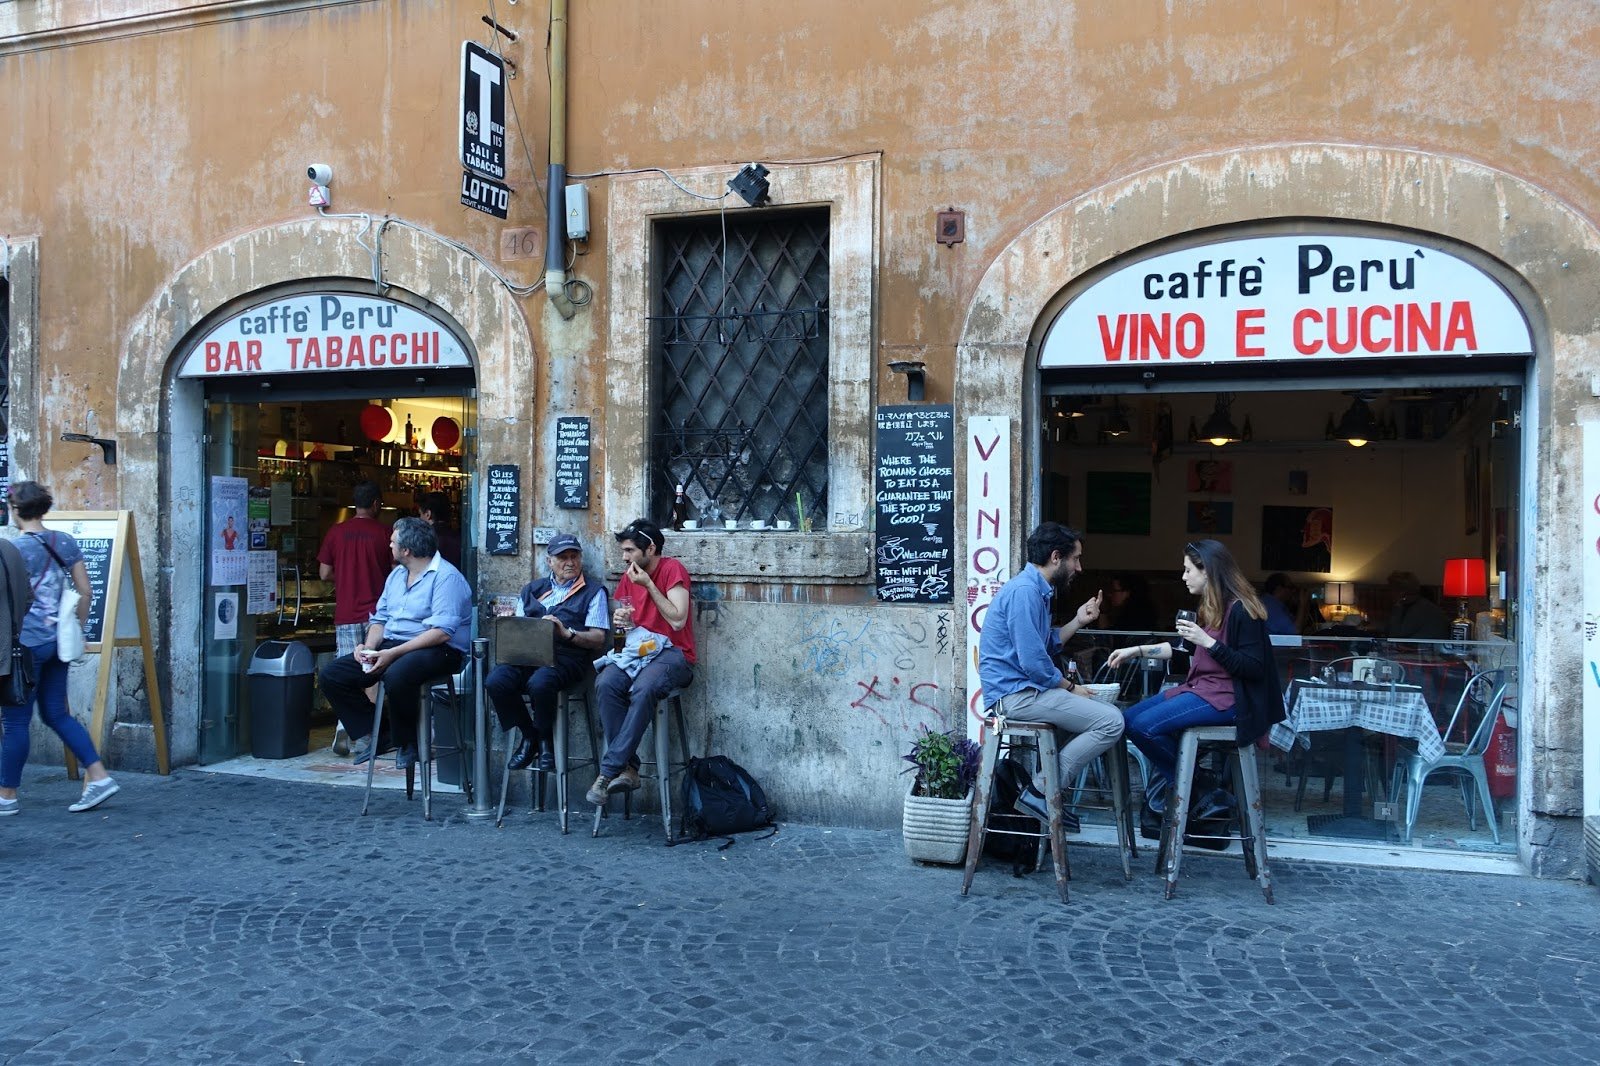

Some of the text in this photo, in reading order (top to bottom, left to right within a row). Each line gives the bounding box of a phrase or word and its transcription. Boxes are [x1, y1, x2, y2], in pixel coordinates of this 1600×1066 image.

[469, 51, 501, 147] T
[470, 142, 499, 163] SALI E
[465, 152, 503, 178] TABACCHI
[462, 174, 509, 211] LOTTO
[504, 231, 538, 255] 46
[1143, 257, 1266, 300] caffè
[239, 305, 311, 335] caffè
[1097, 301, 1479, 362] VINO E CUCINA
[205, 331, 440, 373] BAR TABACCHI
[904, 431, 925, 441] カフェ
[880, 454, 937, 466] WHERE THE
[878, 466, 952, 477] ROMANS CHOOSE
[898, 478, 917, 488] EAT
[919, 479, 930, 487] IS
[931, 479, 940, 488] A
[876, 490, 953, 502] GUARANTEE THAT
[973, 434, 1001, 575] VINO
[880, 503, 941, 514] THE FOOD IS
[890, 513, 925, 525] GOOD!
[879, 567, 900, 576] FREE
